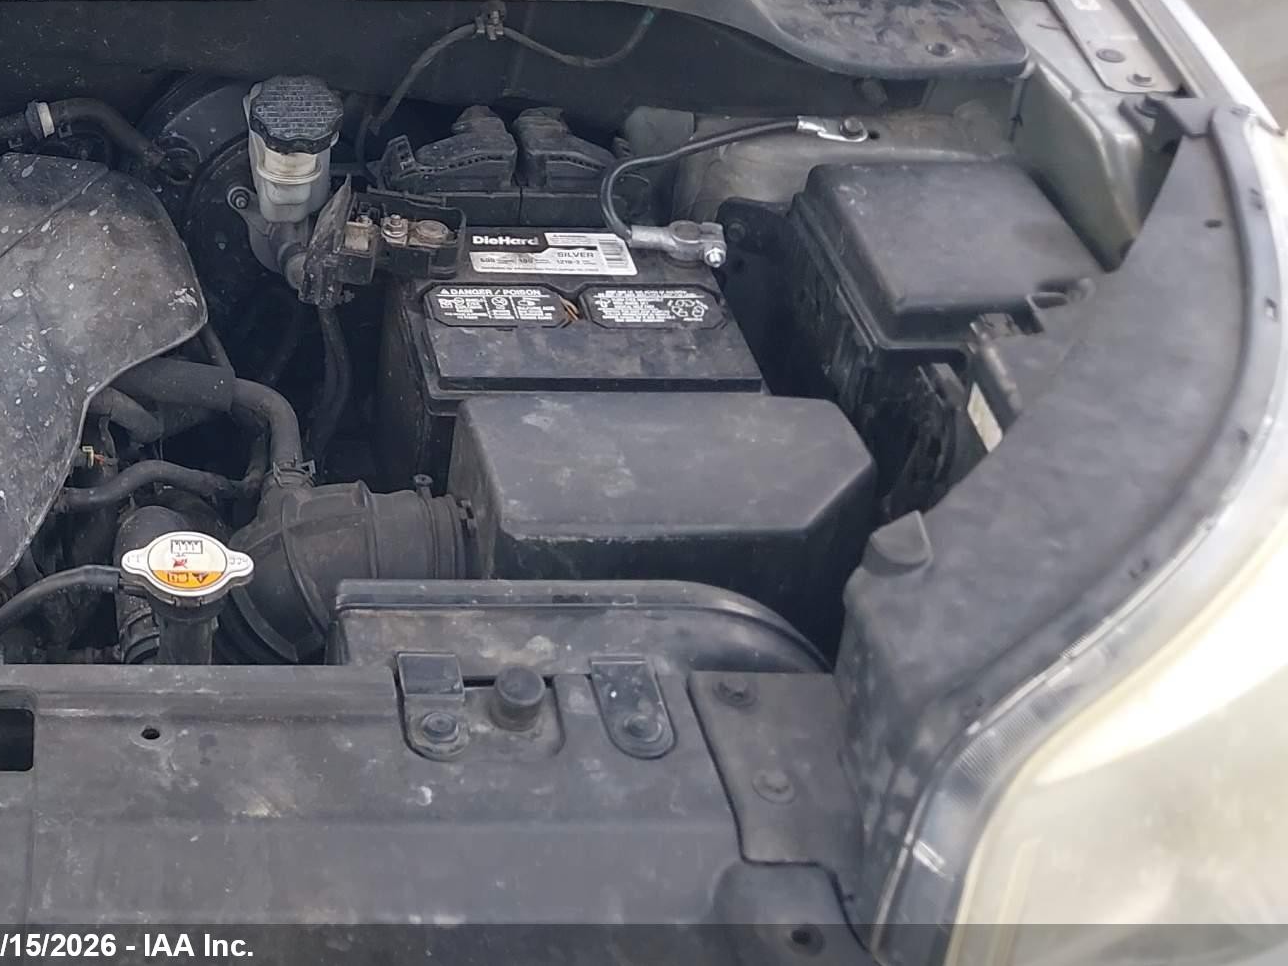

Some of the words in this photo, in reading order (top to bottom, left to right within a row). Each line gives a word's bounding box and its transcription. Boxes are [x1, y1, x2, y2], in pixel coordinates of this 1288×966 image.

[472, 235, 539, 246] DieHard
[557, 251, 594, 259] SILVER
[449, 288, 494, 296] DANGER
[503, 288, 542, 296] POISON
